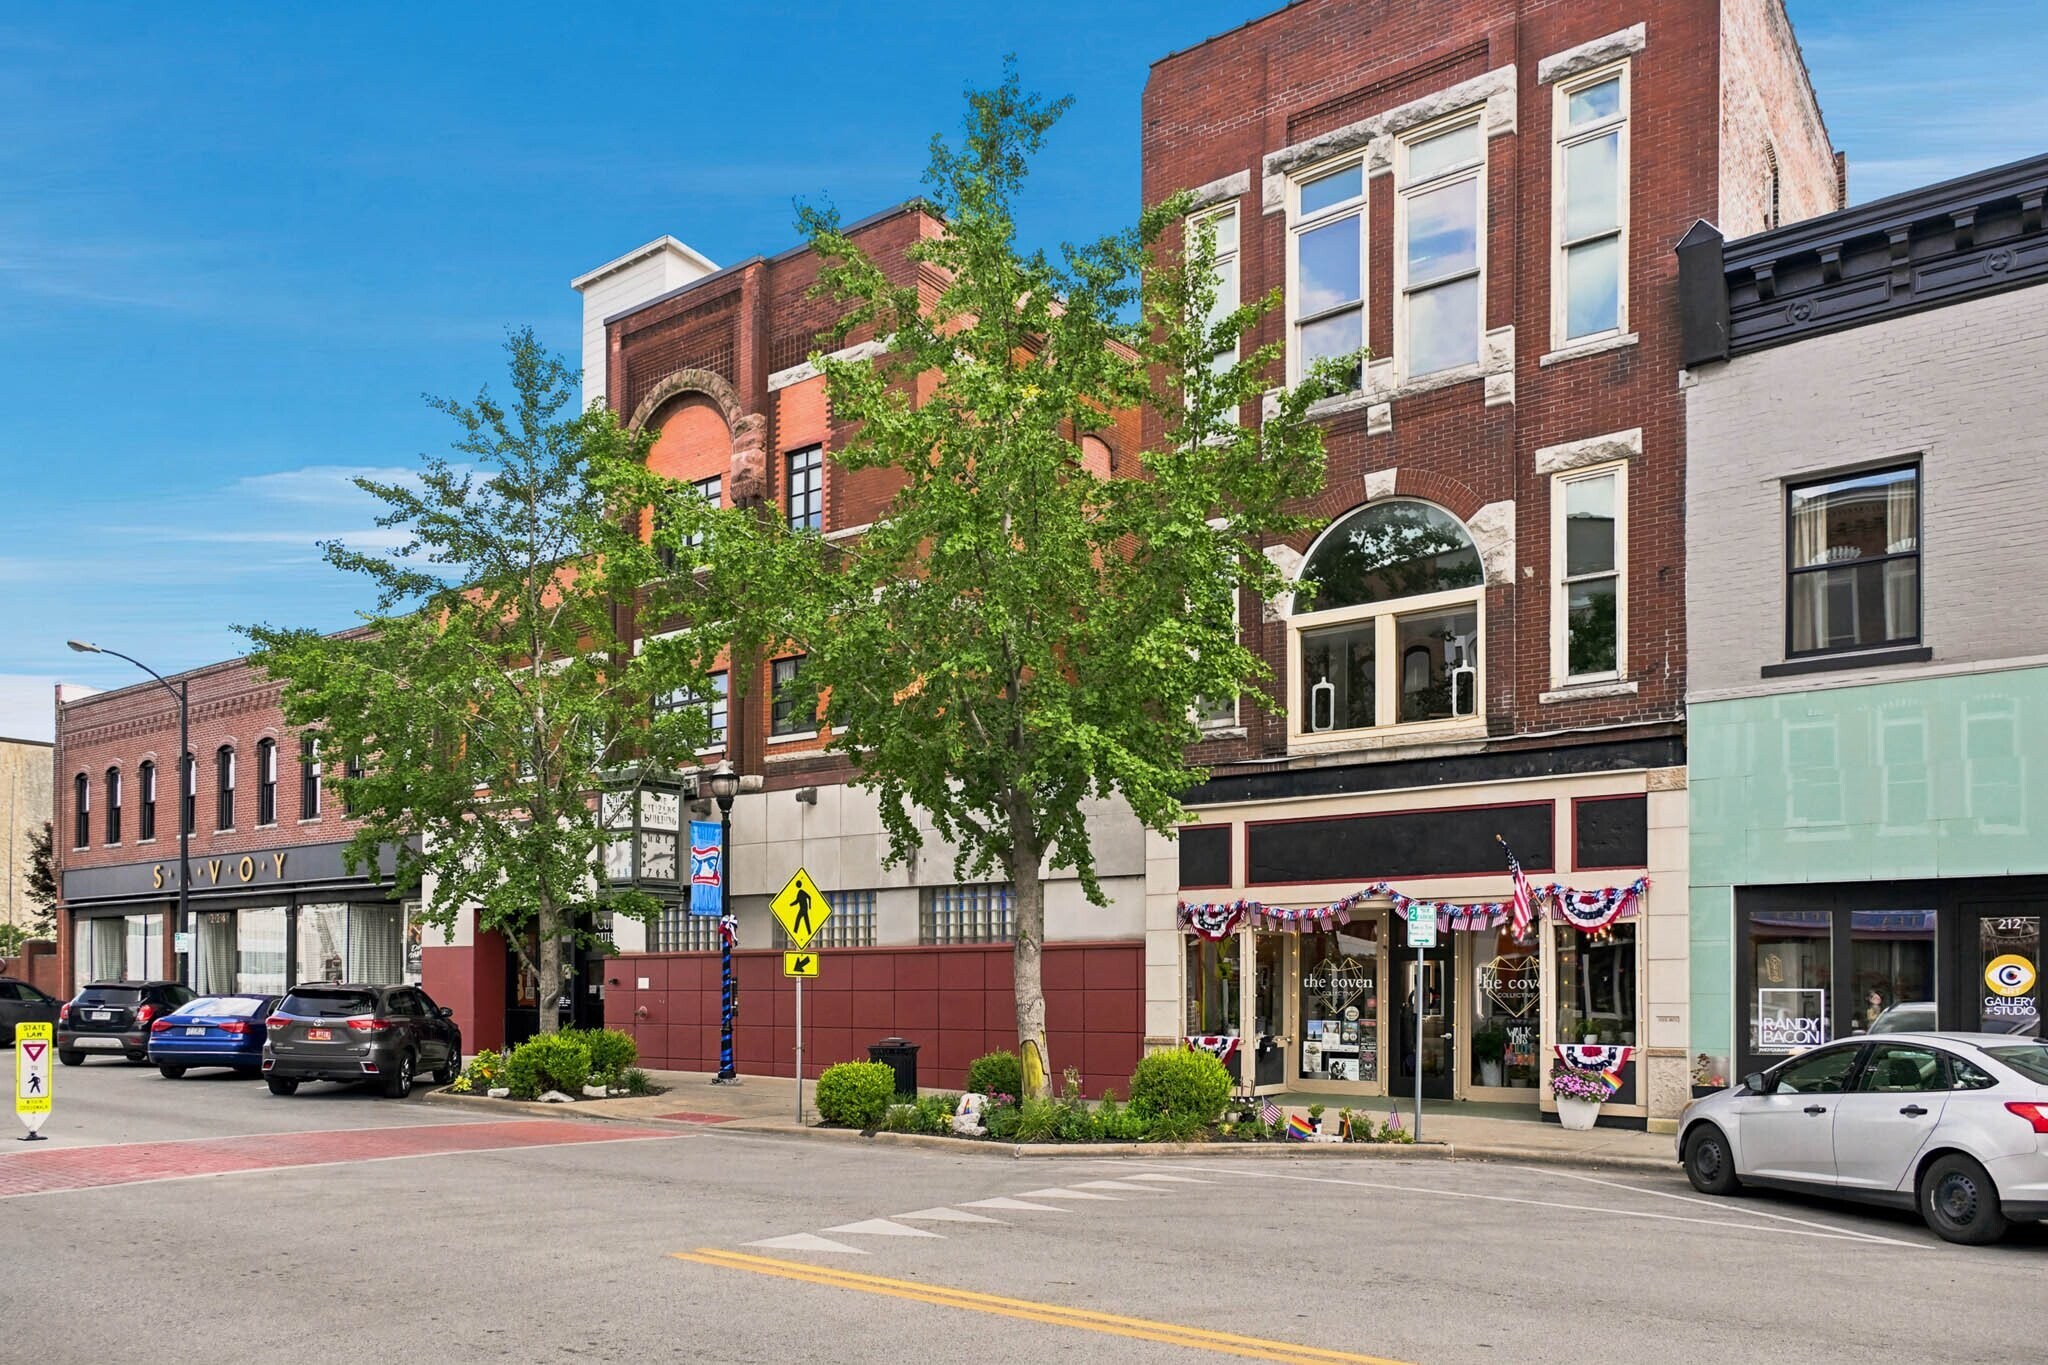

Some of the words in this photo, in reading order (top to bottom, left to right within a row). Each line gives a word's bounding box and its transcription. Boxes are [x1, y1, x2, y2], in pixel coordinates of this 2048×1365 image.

[153, 852, 285, 889] SVOY
[1997, 918, 2021, 930] 212
[1303, 973, 1327, 988] the
[1330, 978, 1374, 988] coven
[1984, 997, 2036, 1007] GALLERY
[23, 1024, 46, 1032] STATE
[1763, 1017, 1820, 1031] RANDY
[1506, 1026, 1532, 1038] WALK
[1763, 1030, 1820, 1044] BACON
